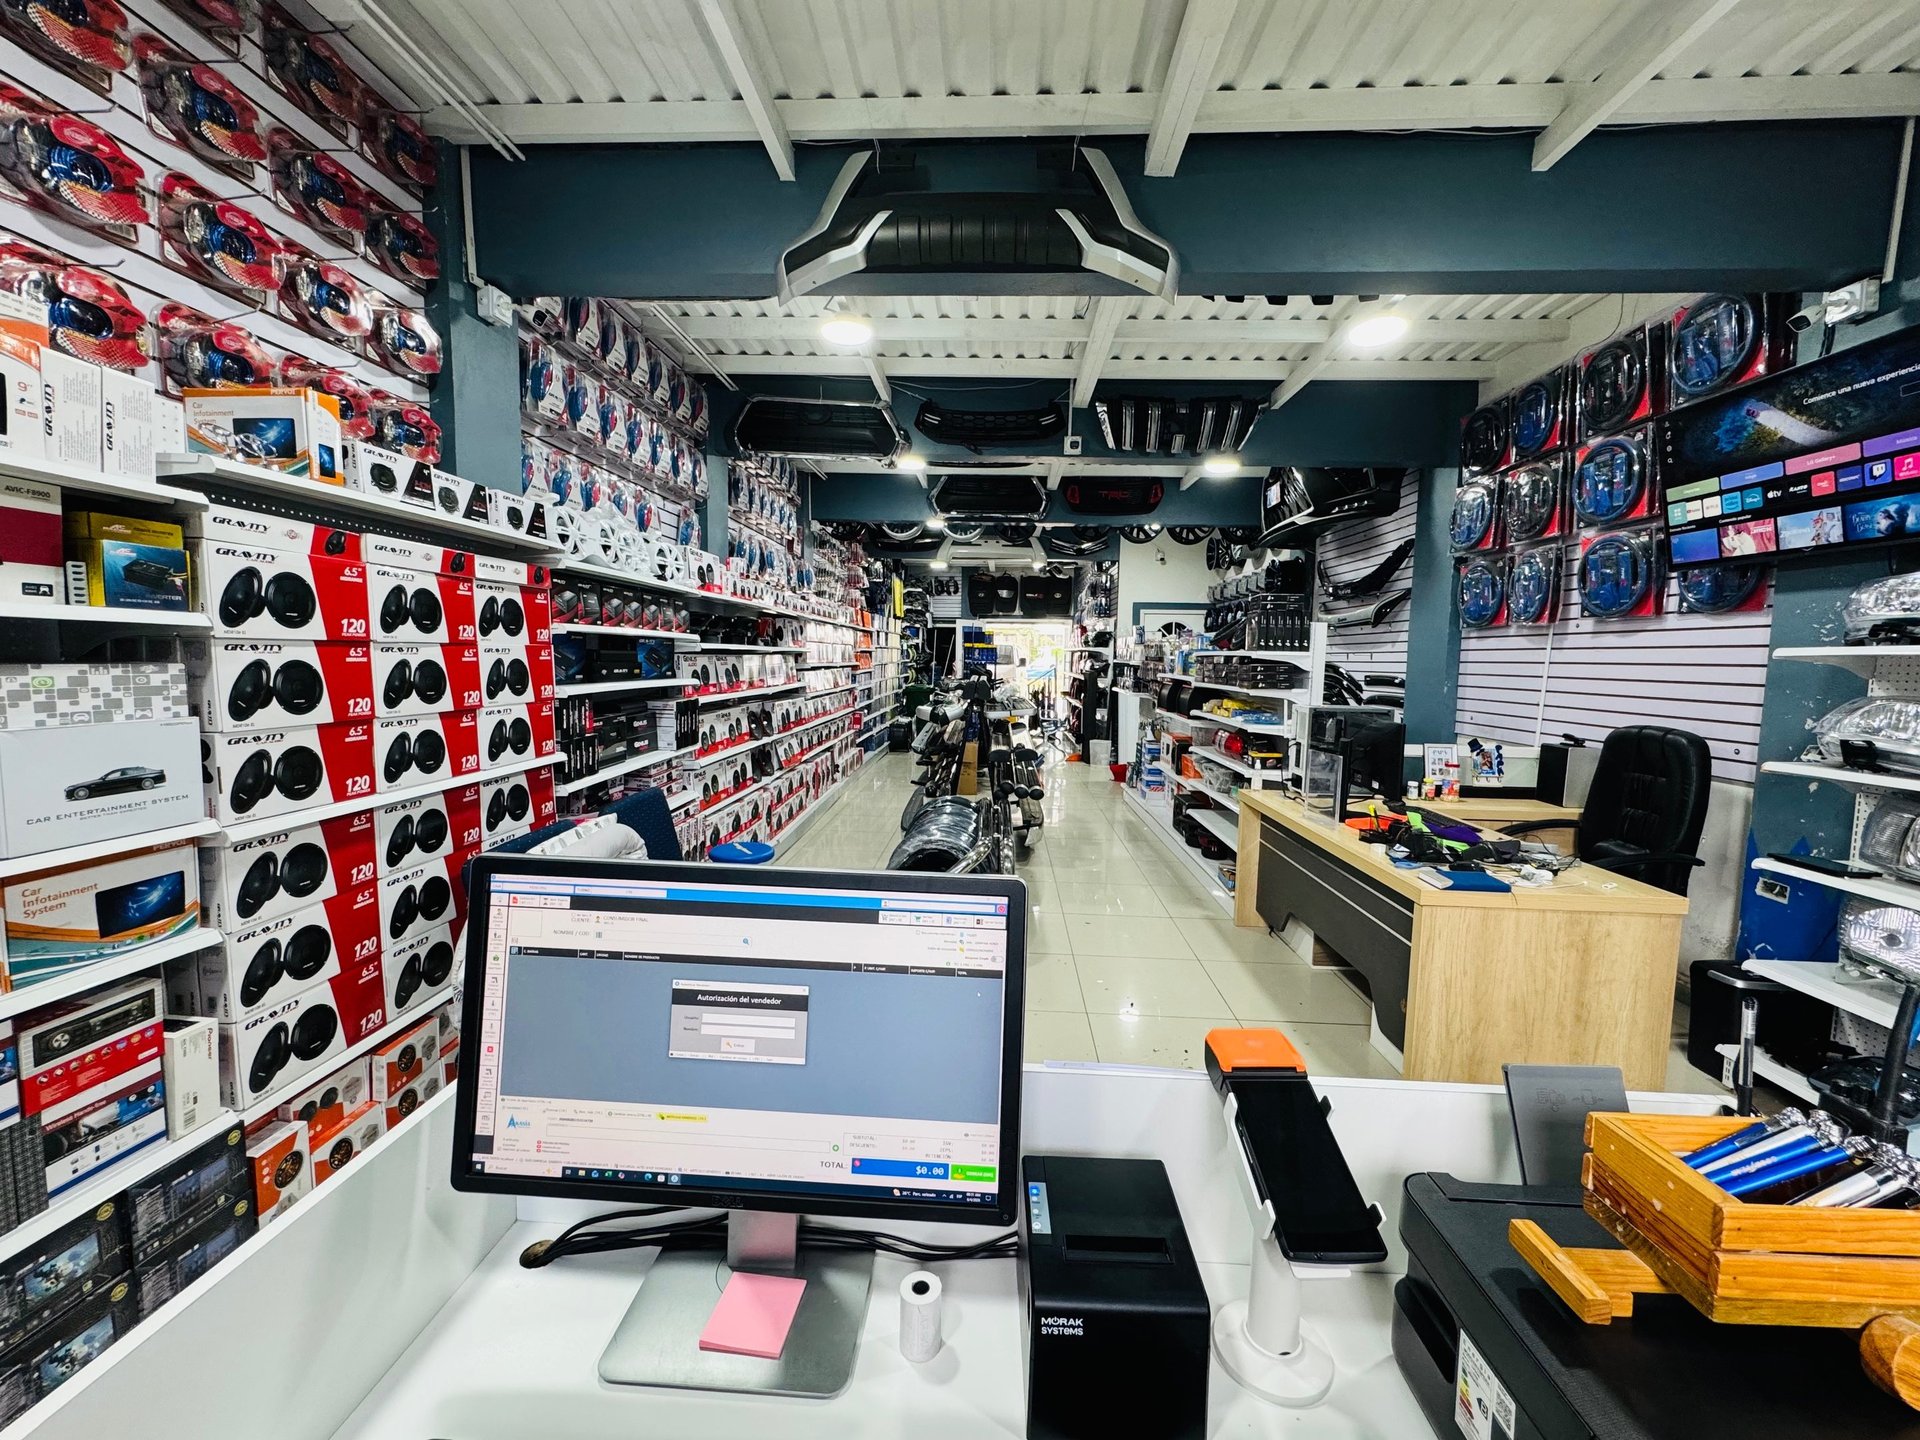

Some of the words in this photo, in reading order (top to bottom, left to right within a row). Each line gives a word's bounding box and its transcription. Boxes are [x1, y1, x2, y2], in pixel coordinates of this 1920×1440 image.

[1803, 390, 1837, 405] Comience
[1837, 386, 1851, 394] una
[1853, 379, 1875, 389] nueva
[364, 448, 398, 463] GRAVITY
[212, 516, 271, 532] GRAVITY
[216, 548, 279, 562] GRAVITY
[375, 544, 414, 556] GRAVITY
[344, 567, 362, 576] 6.5"
[479, 562, 506, 572] GRAVITY
[377, 570, 416, 581] GRAVITY
[459, 583, 472, 591] 6.5"
[476, 584, 505, 592] GRAVITY
[341, 619, 366, 633] 120
[458, 625, 475, 638] 120
[536, 629, 549, 640] 120
[224, 643, 285, 653] GRAVITY
[349, 647, 367, 657] 6.5"
[464, 649, 477, 657] 6.5"
[464, 691, 480, 702] 120
[541, 686, 552, 696] 120
[348, 698, 371, 713] 120
[381, 719, 418, 728] GRAVITY
[462, 713, 474, 722] 6.5"
[349, 725, 367, 735] 6.5"
[228, 732, 287, 746] GRAVITY
[542, 740, 553, 750] 120
[462, 755, 477, 767] 120
[346, 775, 370, 792] 120
[483, 777, 510, 787] GRAVITY
[466, 787, 478, 796] 6.5"
[26, 816, 51, 826] CAR
[56, 800, 148, 820] ENTERTAINMENT
[151, 794, 189, 806] SYSTEM
[385, 800, 423, 814] GRAVITY
[542, 801, 553, 814] 120
[353, 814, 370, 826] 6.5"
[233, 832, 290, 852] GRAVITY
[463, 828, 480, 843] 120
[351, 862, 374, 880] 120
[387, 868, 425, 887] GRAVITY
[22, 886, 42, 898] Car
[22, 883, 98, 908] Infotainment
[356, 888, 374, 902] 6.5"
[23, 900, 66, 918] System
[237, 916, 296, 943] GRAVITY
[355, 937, 377, 958] 120
[393, 935, 429, 958] GRAVITY
[361, 962, 378, 977] 6.5"
[697, 994, 738, 1003] Autorización
[739, 996, 750, 1004] del
[751, 997, 782, 1005] vendedor
[245, 999, 301, 1031] GRAVITY
[361, 1009, 382, 1032] 120
[820, 1161, 848, 1169] TOTAL:
[916, 1165, 945, 1175] $0.00
[1041, 1316, 1083, 1326] MORAK
